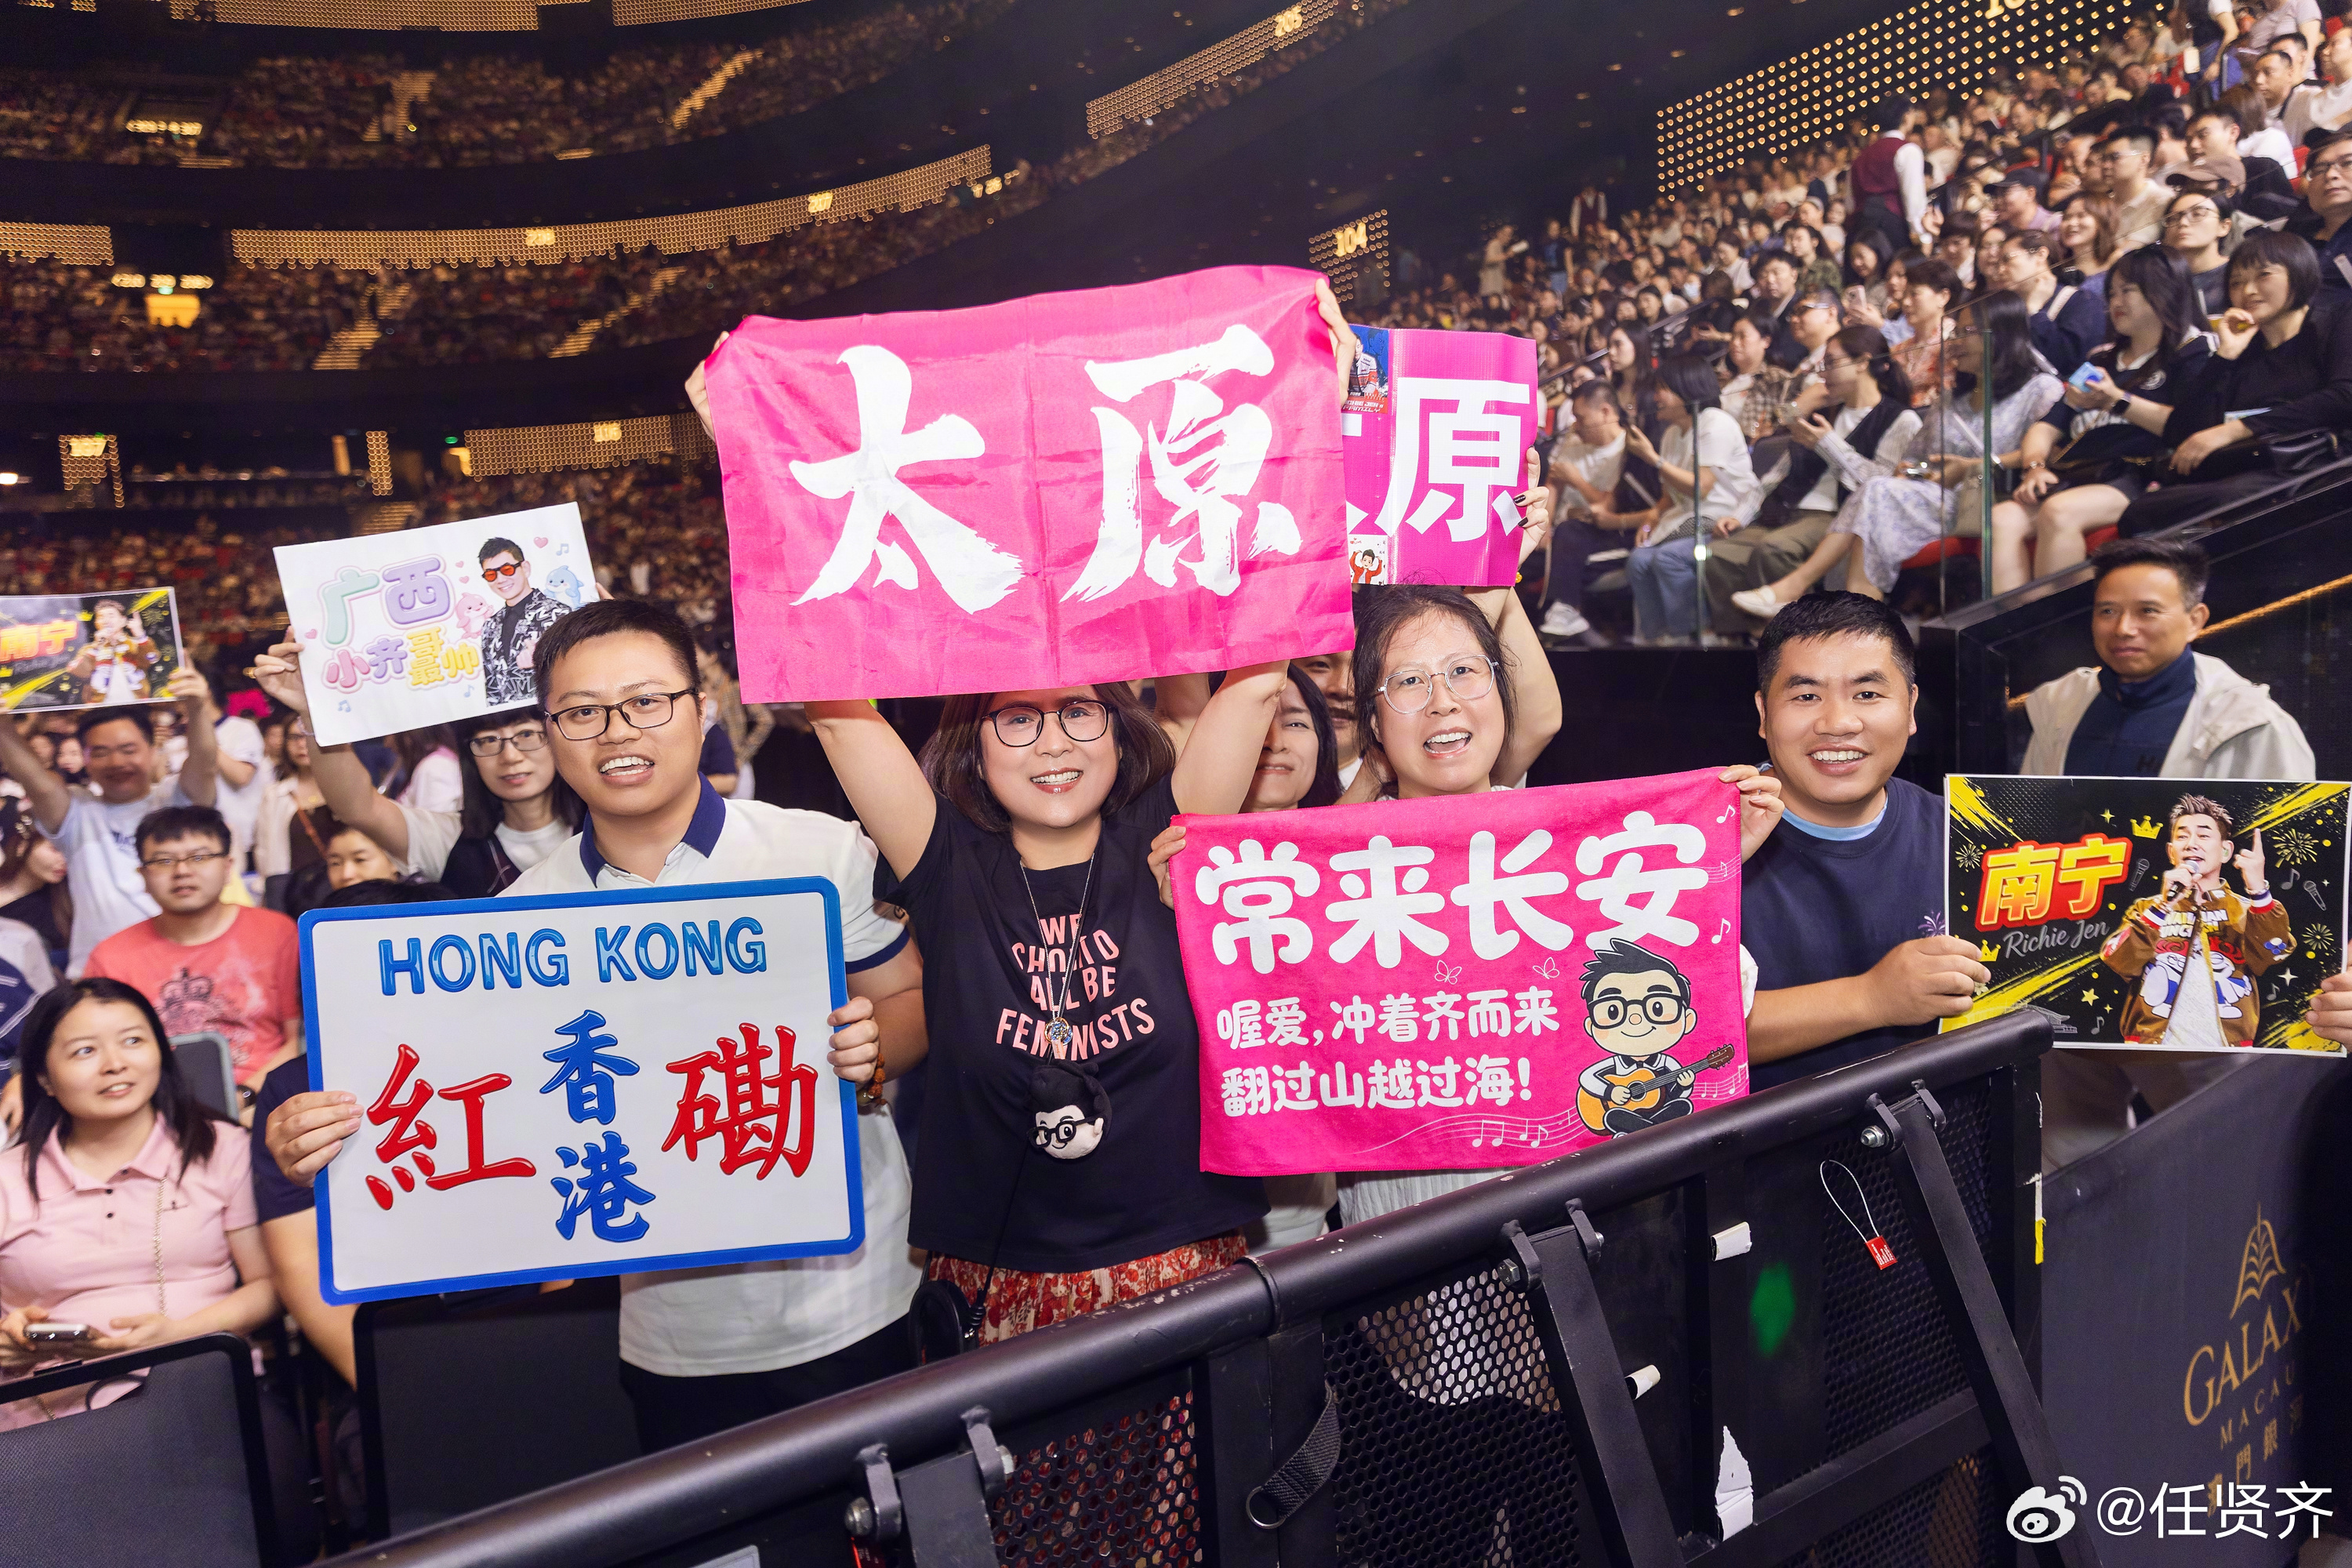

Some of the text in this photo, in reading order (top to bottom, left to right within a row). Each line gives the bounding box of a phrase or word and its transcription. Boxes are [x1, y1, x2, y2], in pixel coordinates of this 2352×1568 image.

[1275, 5, 1302, 37] 205
[1335, 222, 1368, 256] 104
[789, 324, 1301, 615] 太原
[1343, 377, 1530, 542] 原
[322, 557, 451, 645] 广西
[1196, 811, 1709, 975] 常来长安
[1980, 837, 2128, 927] 南宁
[378, 916, 768, 996] HONG KONG
[2003, 920, 2110, 959] Richie Jen
[1082, 965, 1116, 1003] BE
[996, 997, 1155, 1062] FEMNISTS
[539, 1010, 656, 1243] 香港
[1220, 1056, 1532, 1118] 翻过山越过海!
[2184, 1280, 2302, 1426] GALAX
